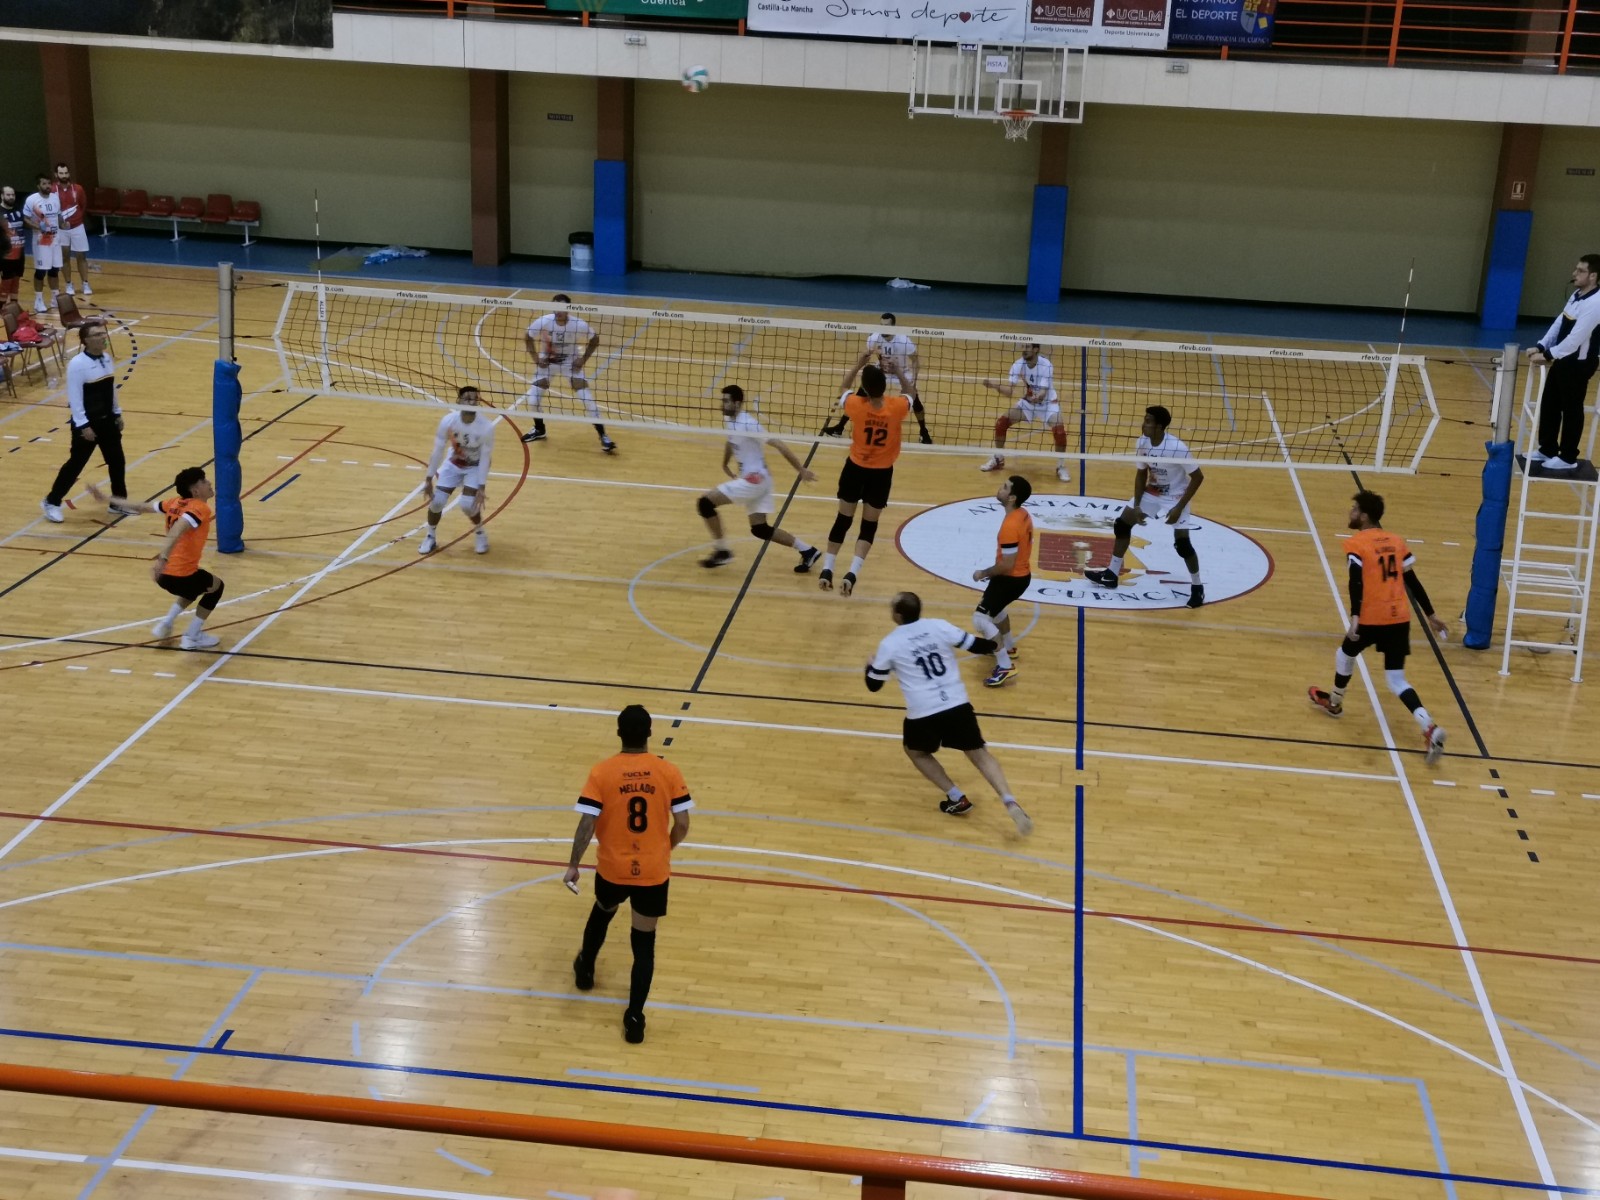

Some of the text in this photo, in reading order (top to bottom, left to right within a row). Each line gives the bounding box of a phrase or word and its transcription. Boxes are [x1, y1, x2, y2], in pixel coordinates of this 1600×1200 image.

[790, 5, 814, 13] Mancha
[1044, 5, 1091, 18] UCLM
[1116, 8, 1163, 21] UCLM
[1175, 8, 1238, 20] EL DEPORTE
[1033, 25, 1089, 34] Deporte Universitario
[45, 203, 53, 212] 10
[481, 297, 513, 306] rfevb.com
[565, 304, 598, 312] rfevb.com
[652, 310, 684, 318] rfevb.com
[738, 316, 771, 325] rfevb.com
[824, 322, 857, 330] rfevb.com
[911, 328, 945, 336] rfevb.com
[1088, 339, 1122, 347] rfevb.com
[1269, 349, 1304, 357] rfevb.com
[863, 427, 889, 447] 12
[1378, 554, 1398, 582] 14
[1037, 587, 1190, 601] CUENCA
[914, 652, 947, 680] 10
[619, 783, 656, 795] MELLADO
[628, 796, 648, 834] 8
